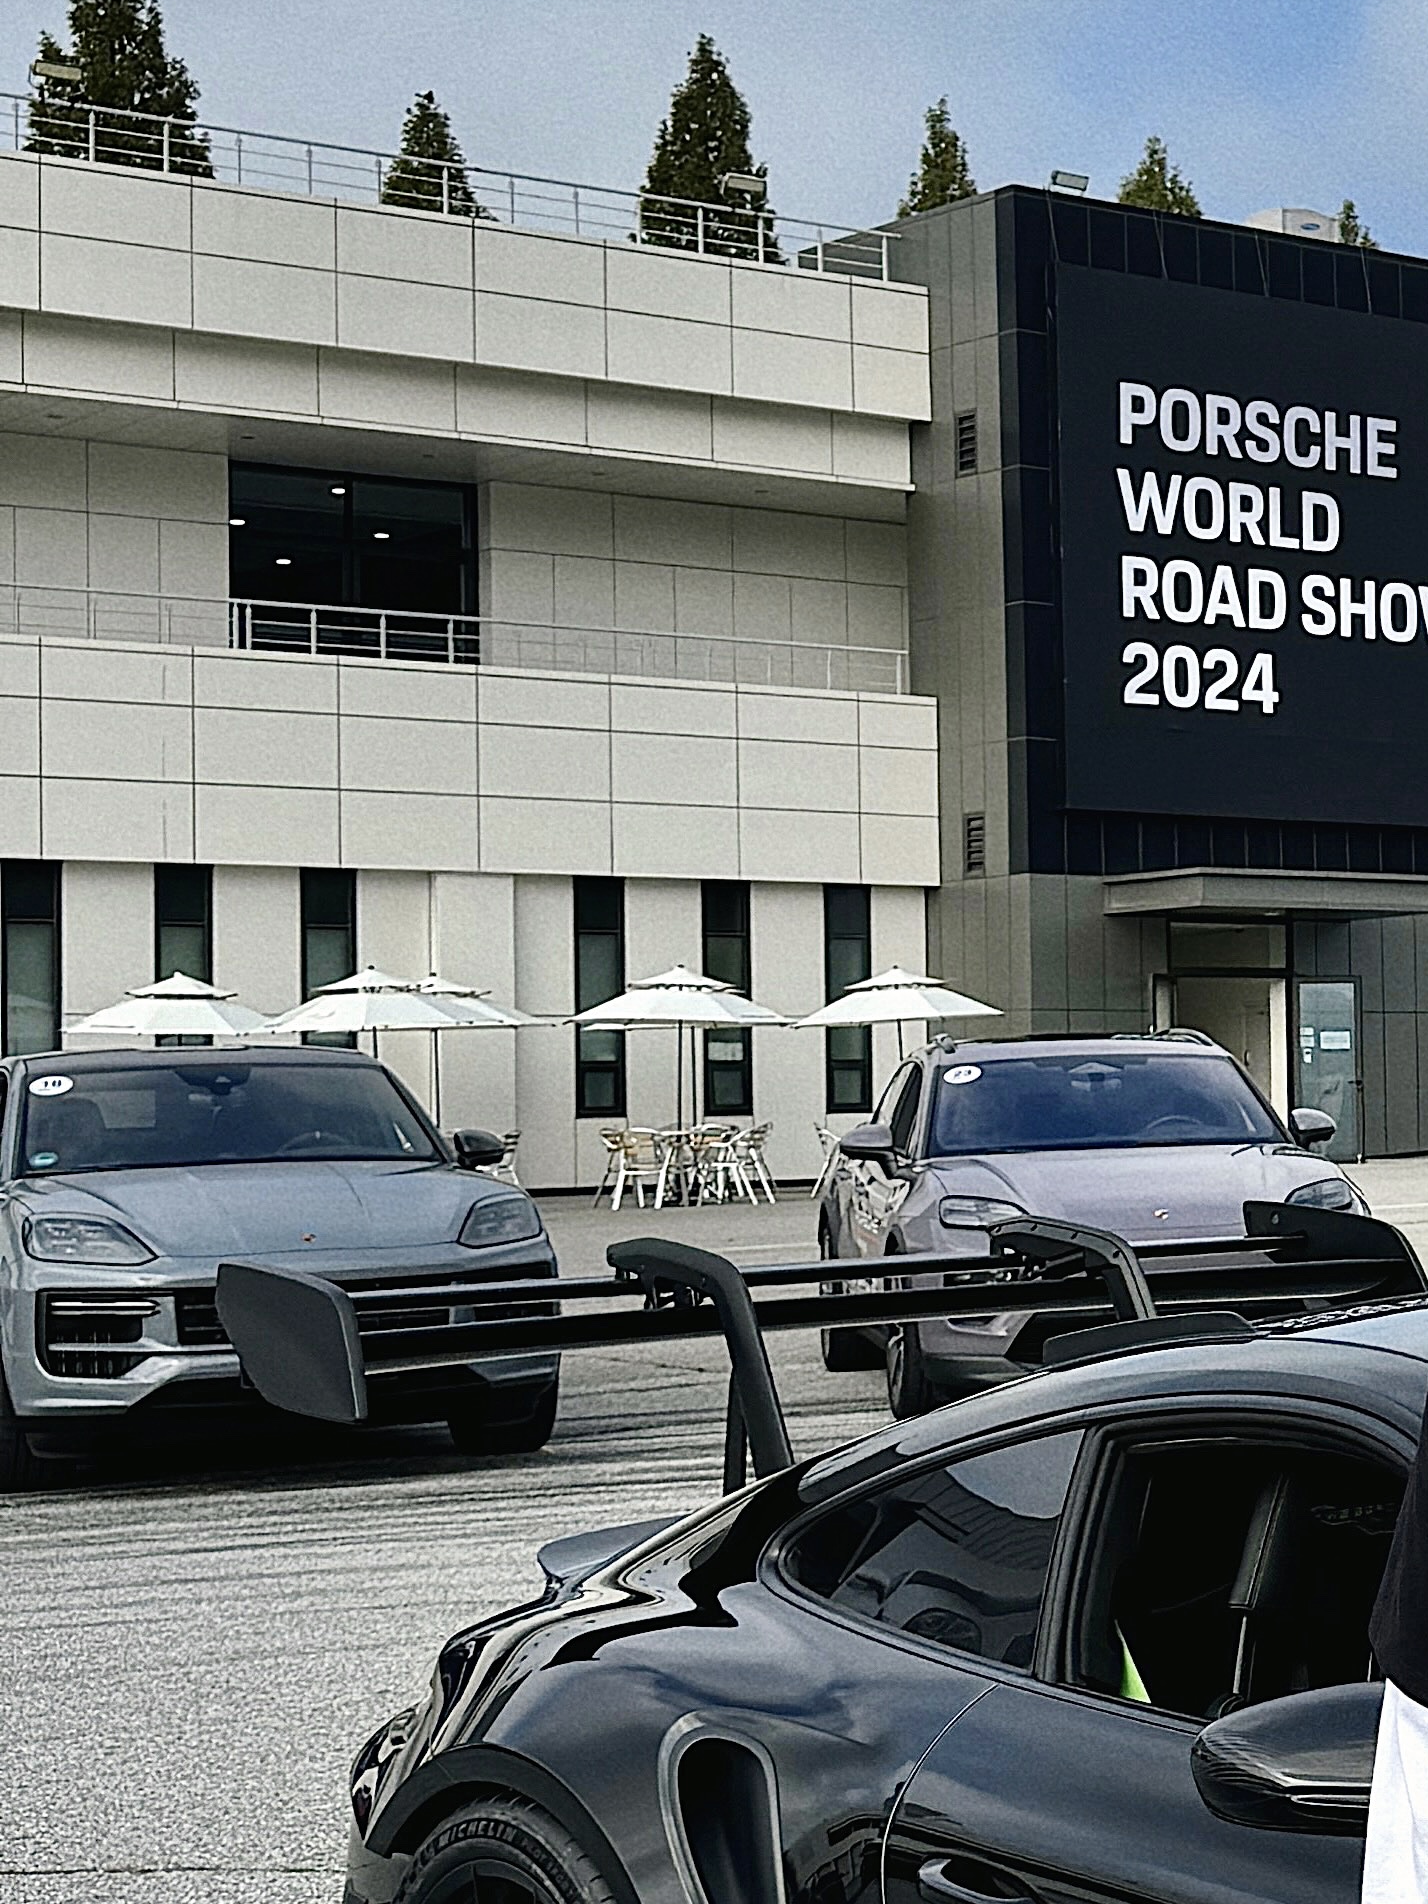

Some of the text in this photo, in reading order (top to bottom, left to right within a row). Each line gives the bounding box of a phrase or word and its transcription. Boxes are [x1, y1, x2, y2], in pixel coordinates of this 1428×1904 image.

[1119, 382, 1397, 478] PORSCHE
[1116, 469, 1340, 552] WORLD
[1122, 556, 1287, 630] ROAD
[1122, 643, 1280, 714] 2024
[438, 1819, 517, 1847] MICHELIN
